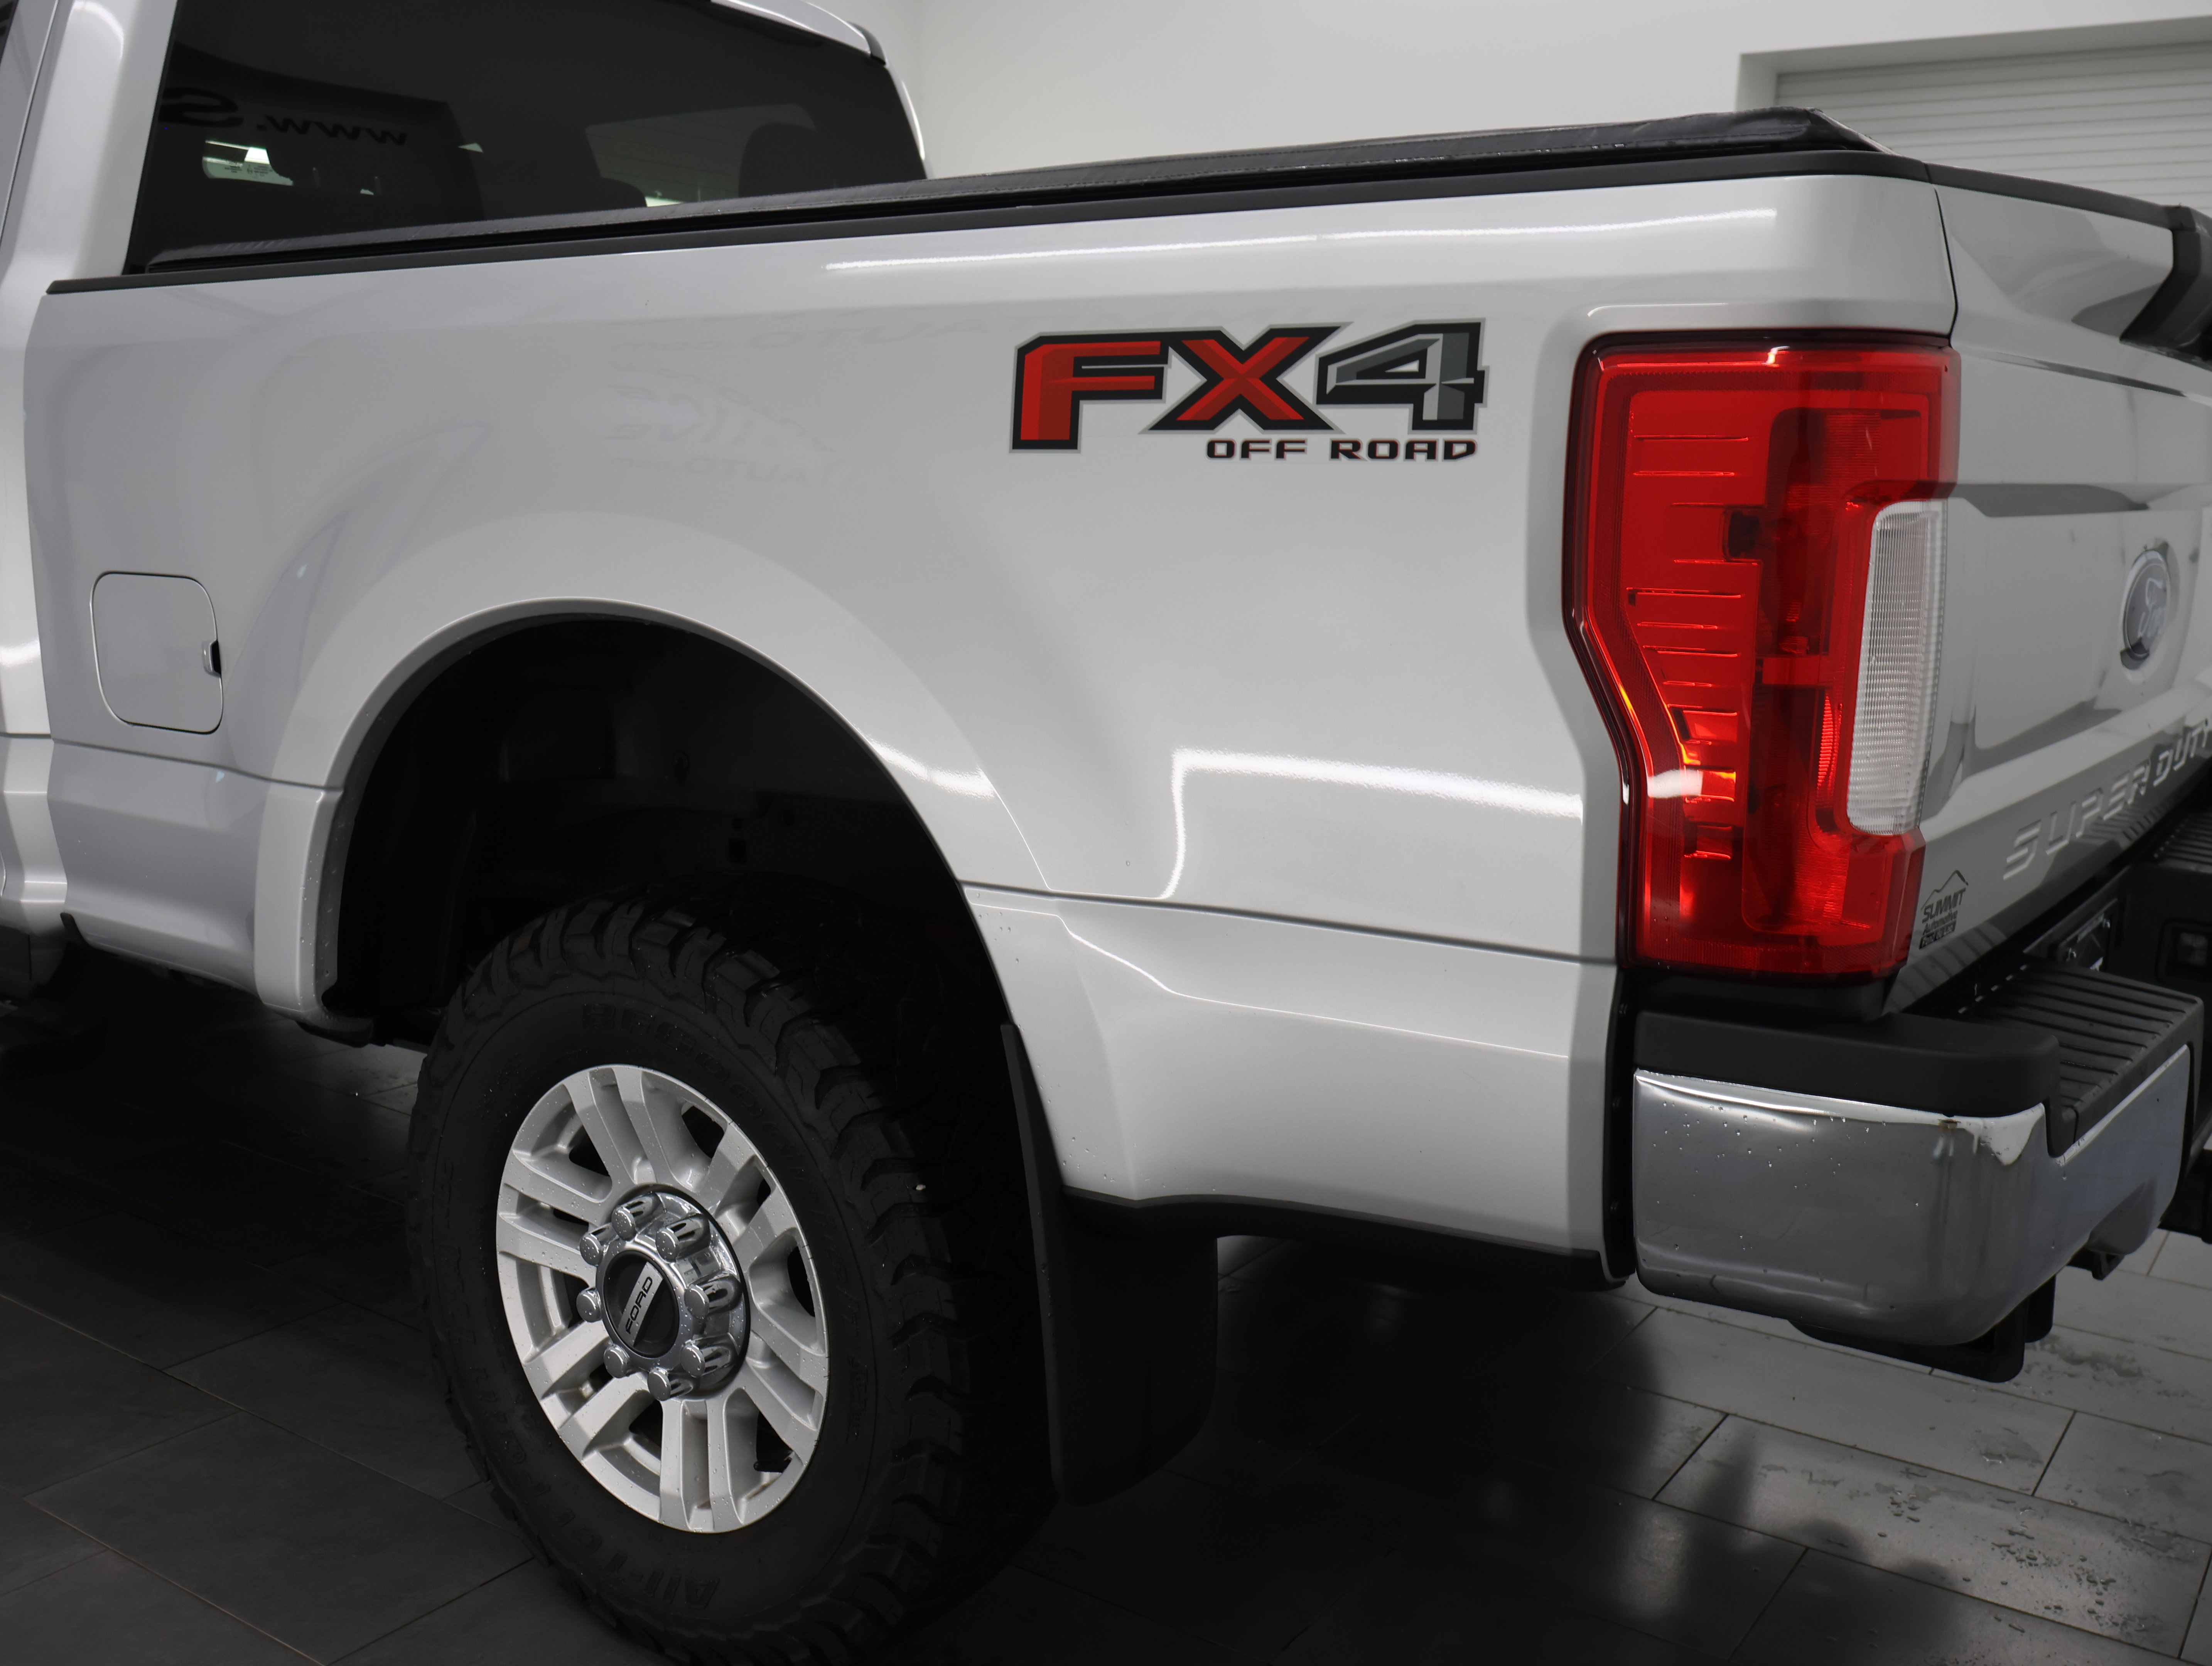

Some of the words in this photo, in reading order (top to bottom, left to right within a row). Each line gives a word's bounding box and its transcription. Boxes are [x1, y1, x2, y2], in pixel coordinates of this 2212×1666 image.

[1009, 318, 1489, 454] FX4
[1205, 438, 1308, 460] OFF
[1329, 438, 1478, 462] ROAD
[2003, 757, 2151, 880] SUPER
[2153, 720, 2209, 787] DUTY
[1922, 887, 1966, 923] SUMMIT
[625, 1276, 653, 1335] FORD
